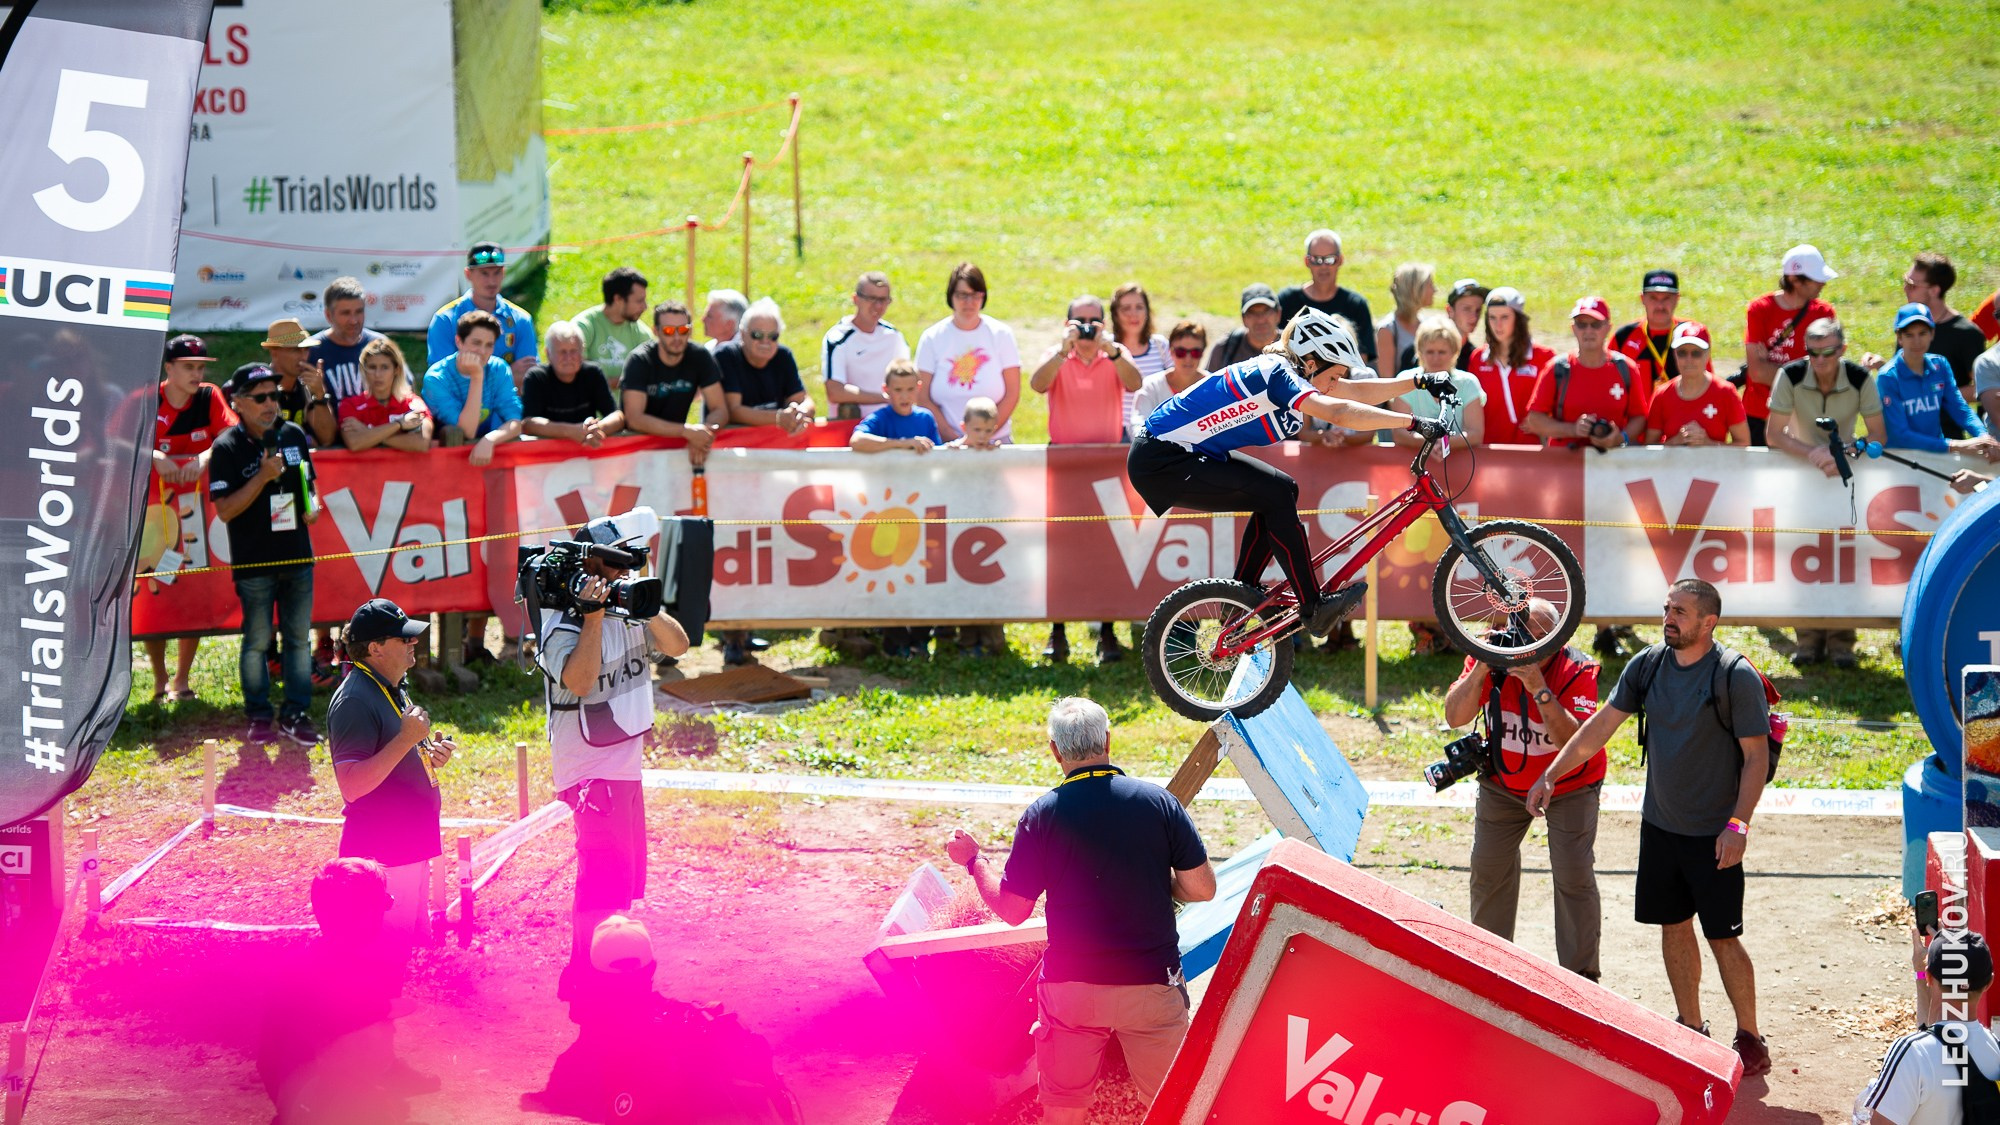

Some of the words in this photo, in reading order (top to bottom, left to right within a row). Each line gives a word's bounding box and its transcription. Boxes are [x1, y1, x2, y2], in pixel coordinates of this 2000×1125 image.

[203, 23, 250, 66] LS
[32, 69, 149, 232] 5
[243, 174, 437, 214] #TrialsWorlds
[12, 268, 111, 315] UCI
[1197, 401, 1259, 432] STRABAG
[1209, 422, 1233, 435] TEAMS
[1903, 394, 1940, 416] TALI
[322, 480, 472, 597] Val
[712, 527, 773, 586] di
[782, 484, 1007, 587] Sole
[1091, 476, 1235, 590] Val
[1625, 478, 1776, 586] Val
[1790, 525, 1857, 585] di
[21, 376, 84, 774] #TrialsWorlds
[0, 824, 32, 834] orlds
[1285, 1014, 1384, 1125] Val
